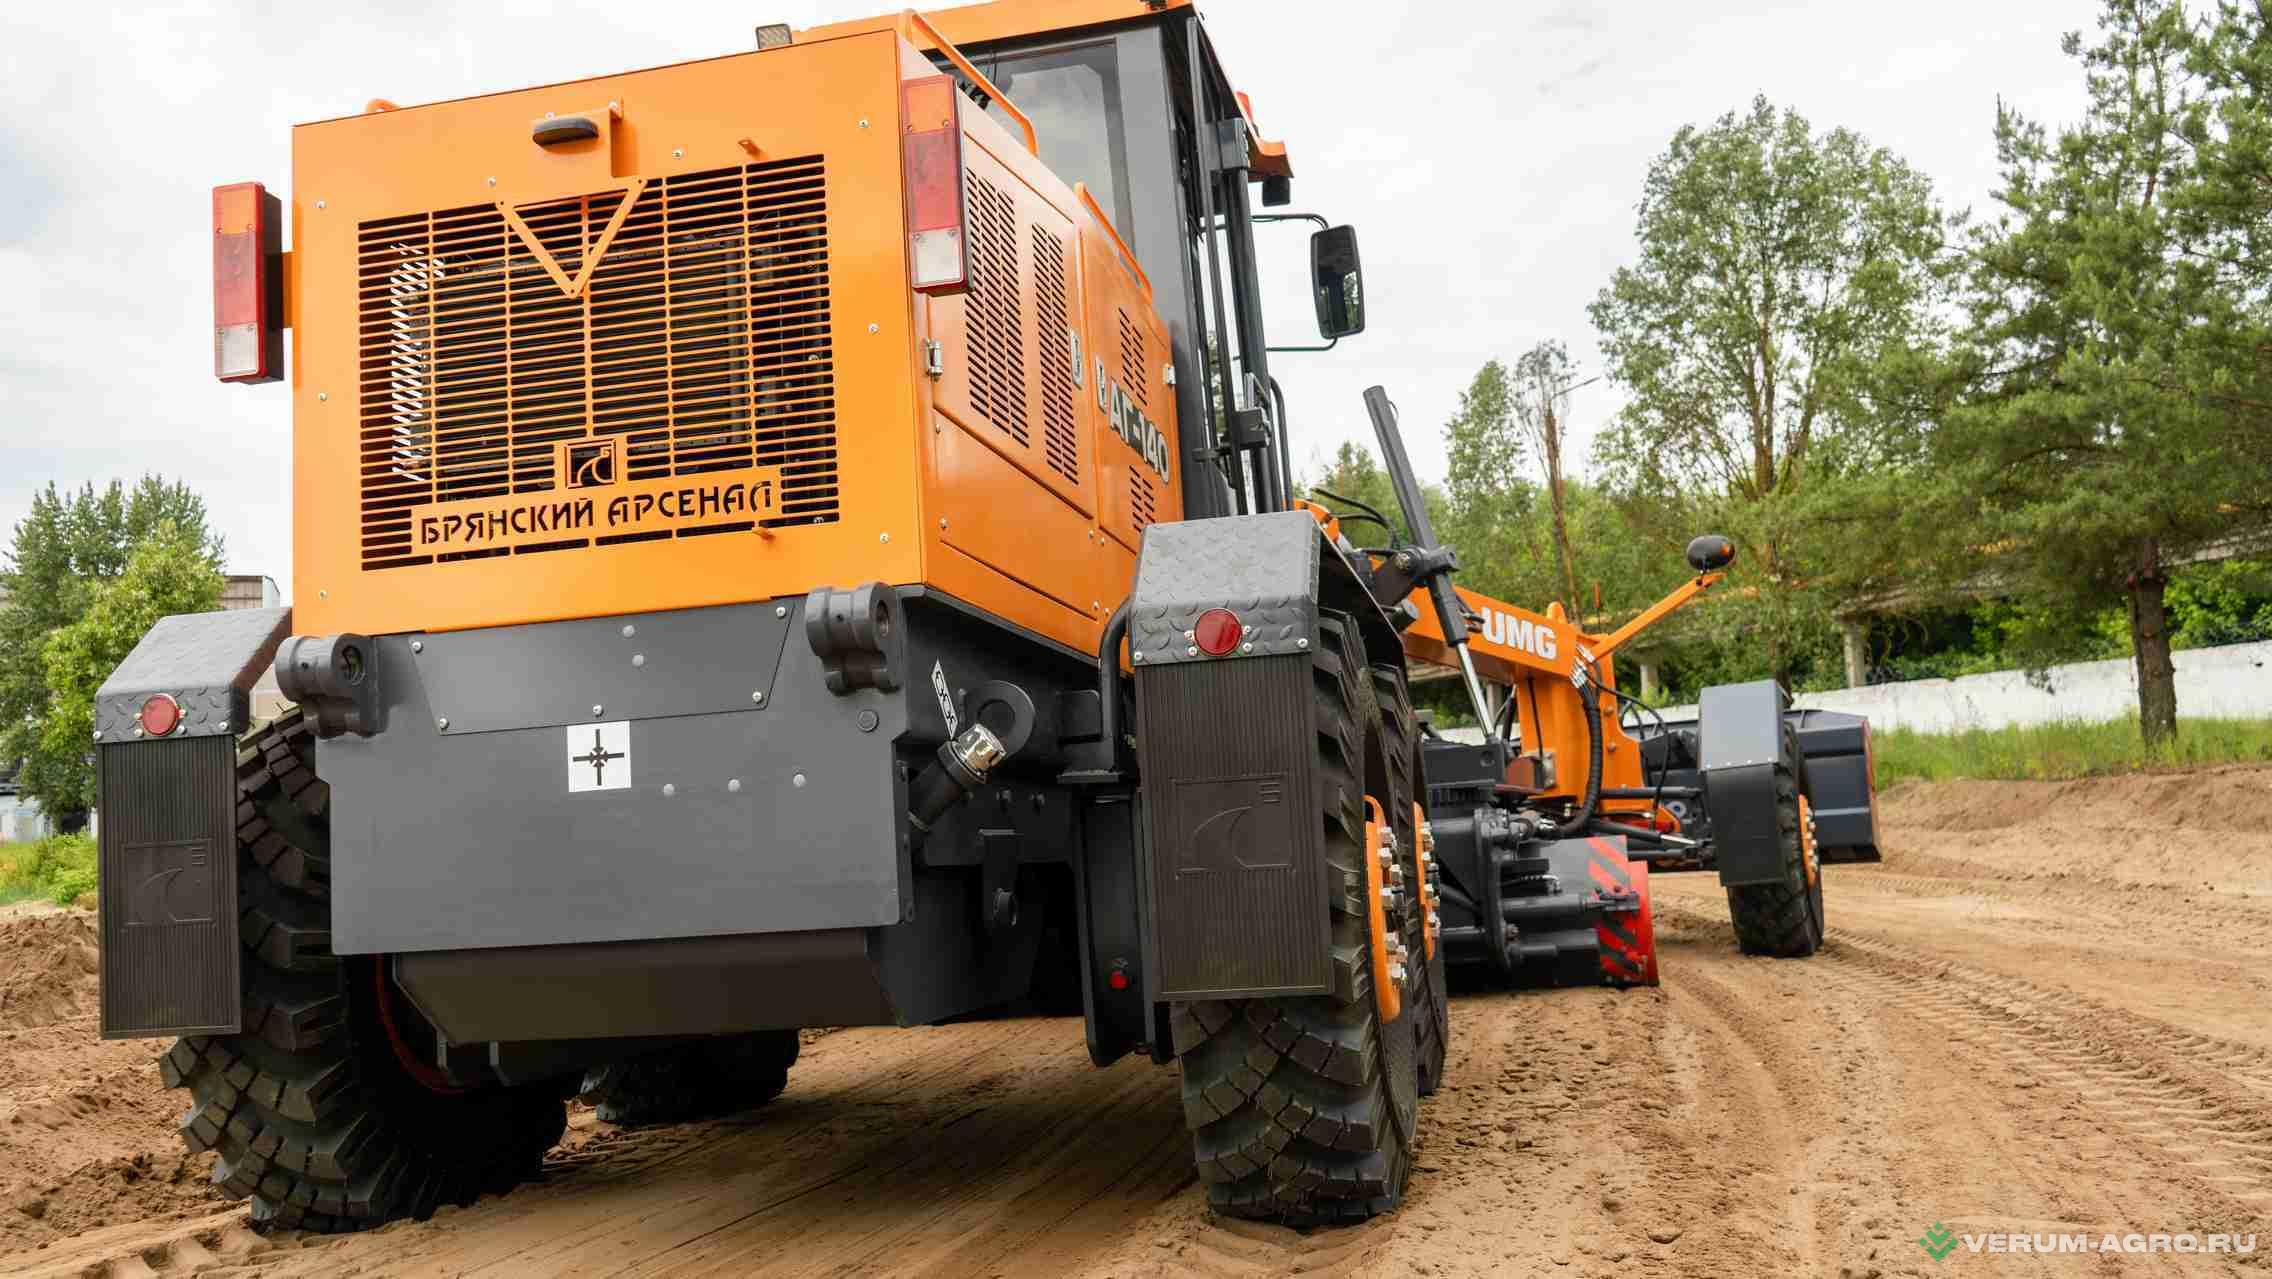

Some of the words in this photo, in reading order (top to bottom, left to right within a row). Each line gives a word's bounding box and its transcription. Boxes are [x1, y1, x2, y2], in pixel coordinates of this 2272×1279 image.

[421, 498, 594, 545] БРЯНСКИЙ
[607, 480, 772, 526] АРСЕНАЛ
[1481, 607, 1557, 660] UMG
